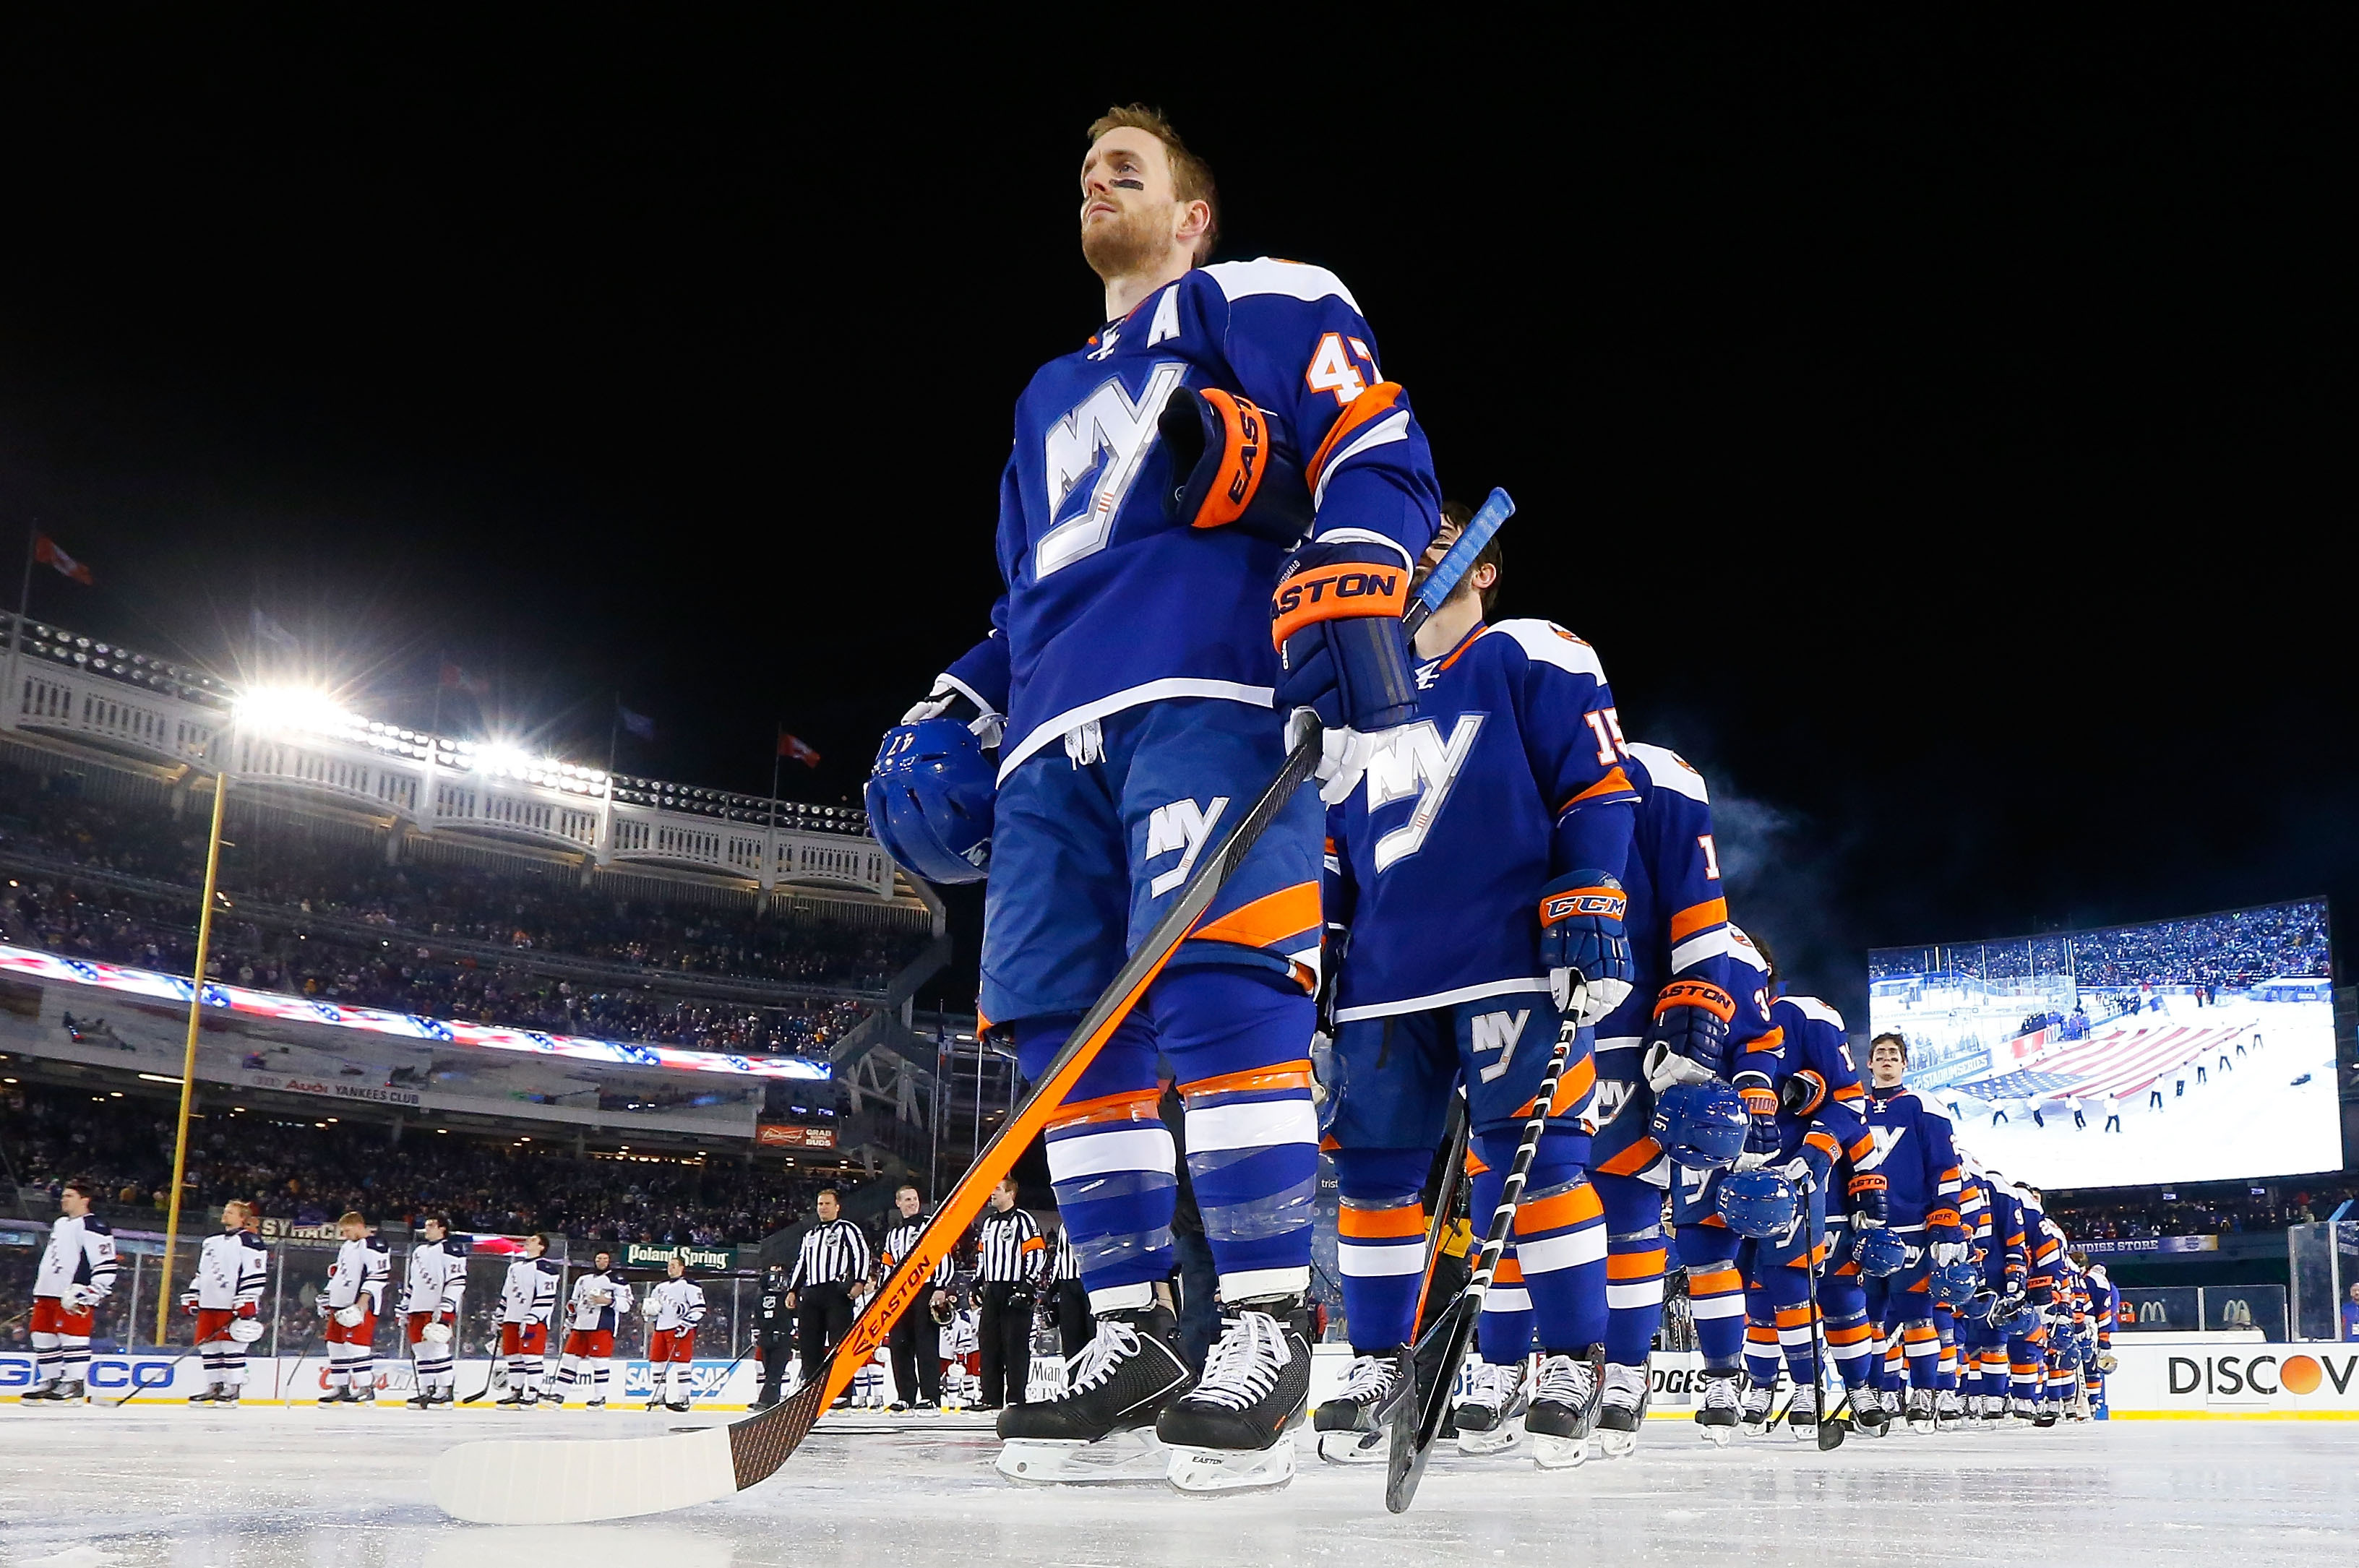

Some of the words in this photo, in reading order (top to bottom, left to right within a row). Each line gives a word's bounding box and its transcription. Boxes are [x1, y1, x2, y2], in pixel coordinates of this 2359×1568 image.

[1148, 284, 1181, 349] A
[1145, 796, 1230, 900] NY
[1546, 895, 1626, 919] CCM
[1753, 986, 1771, 1022] 3
[1471, 1009, 1531, 1085] NY
[335, 1085, 386, 1100] YANKEES
[390, 1092, 419, 1105] CLUB
[805, 1138, 831, 1147] BUDS
[628, 1244, 678, 1264] Poland
[679, 1246, 729, 1270] Spring
[2117, 1239, 2159, 1251] STORE
[867, 1254, 932, 1339] EASTON
[0, 1358, 175, 1388] GCO
[626, 1366, 653, 1392] SA
[689, 1366, 730, 1392] SAP
[1192, 1455, 1224, 1465] EASTON
